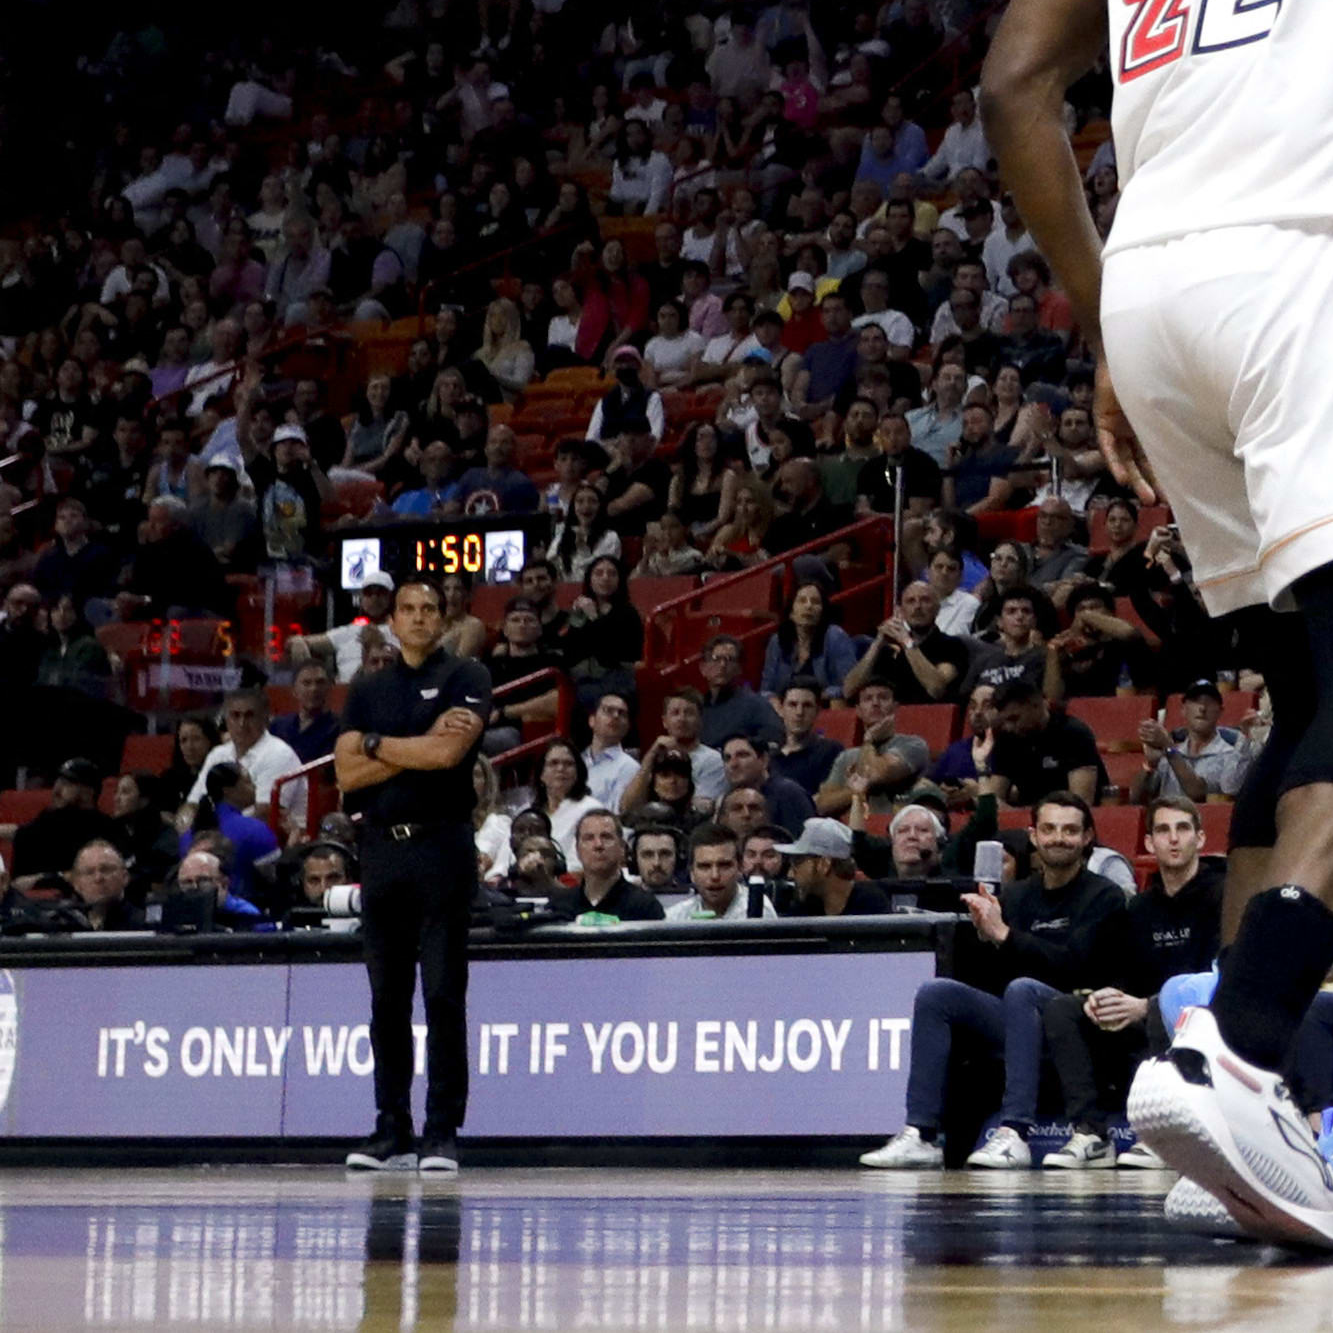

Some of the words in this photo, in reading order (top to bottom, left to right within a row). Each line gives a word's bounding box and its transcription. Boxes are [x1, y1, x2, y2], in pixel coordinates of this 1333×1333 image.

[414, 534, 483, 574] 1:50
[99, 1020, 170, 1077] IT'S
[181, 1025, 293, 1076] ONLY
[304, 1022, 428, 1074] WOT
[480, 1024, 519, 1074] IT
[530, 1023, 568, 1073] IF
[583, 1021, 678, 1073] YOU
[696, 1018, 853, 1072] ENJOY
[869, 1018, 912, 1070] IT
